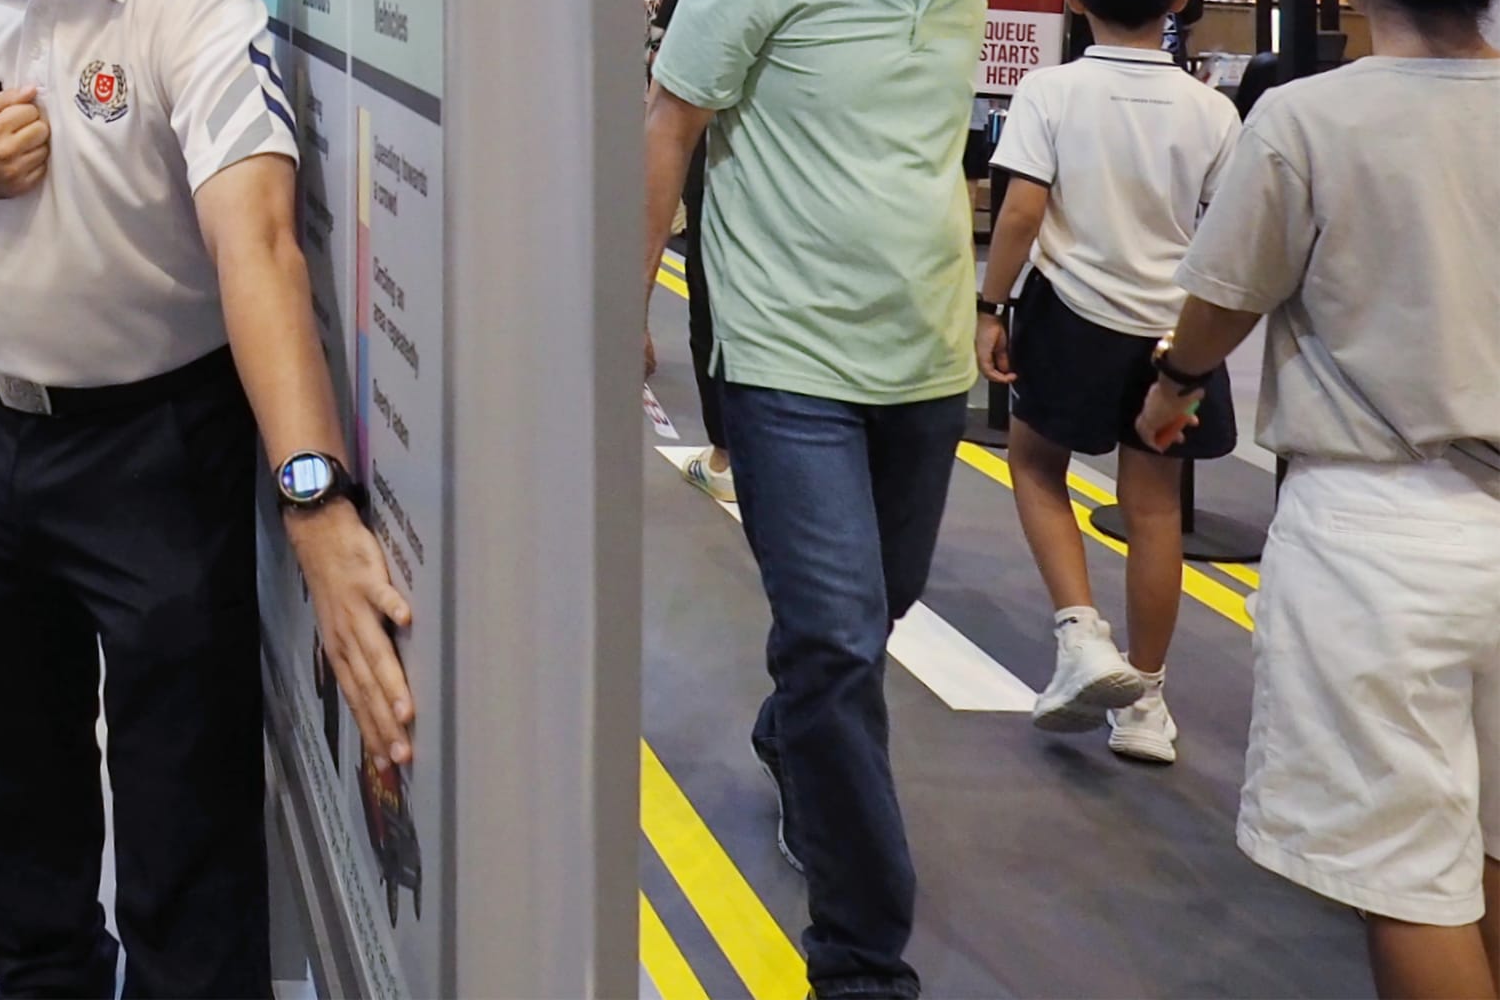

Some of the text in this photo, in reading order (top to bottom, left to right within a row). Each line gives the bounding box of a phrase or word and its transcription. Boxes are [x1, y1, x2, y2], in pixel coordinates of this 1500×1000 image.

[373, 0, 408, 43] Vehicles
[985, 21, 1036, 43] QUEUE
[980, 43, 1040, 65] STARTS
